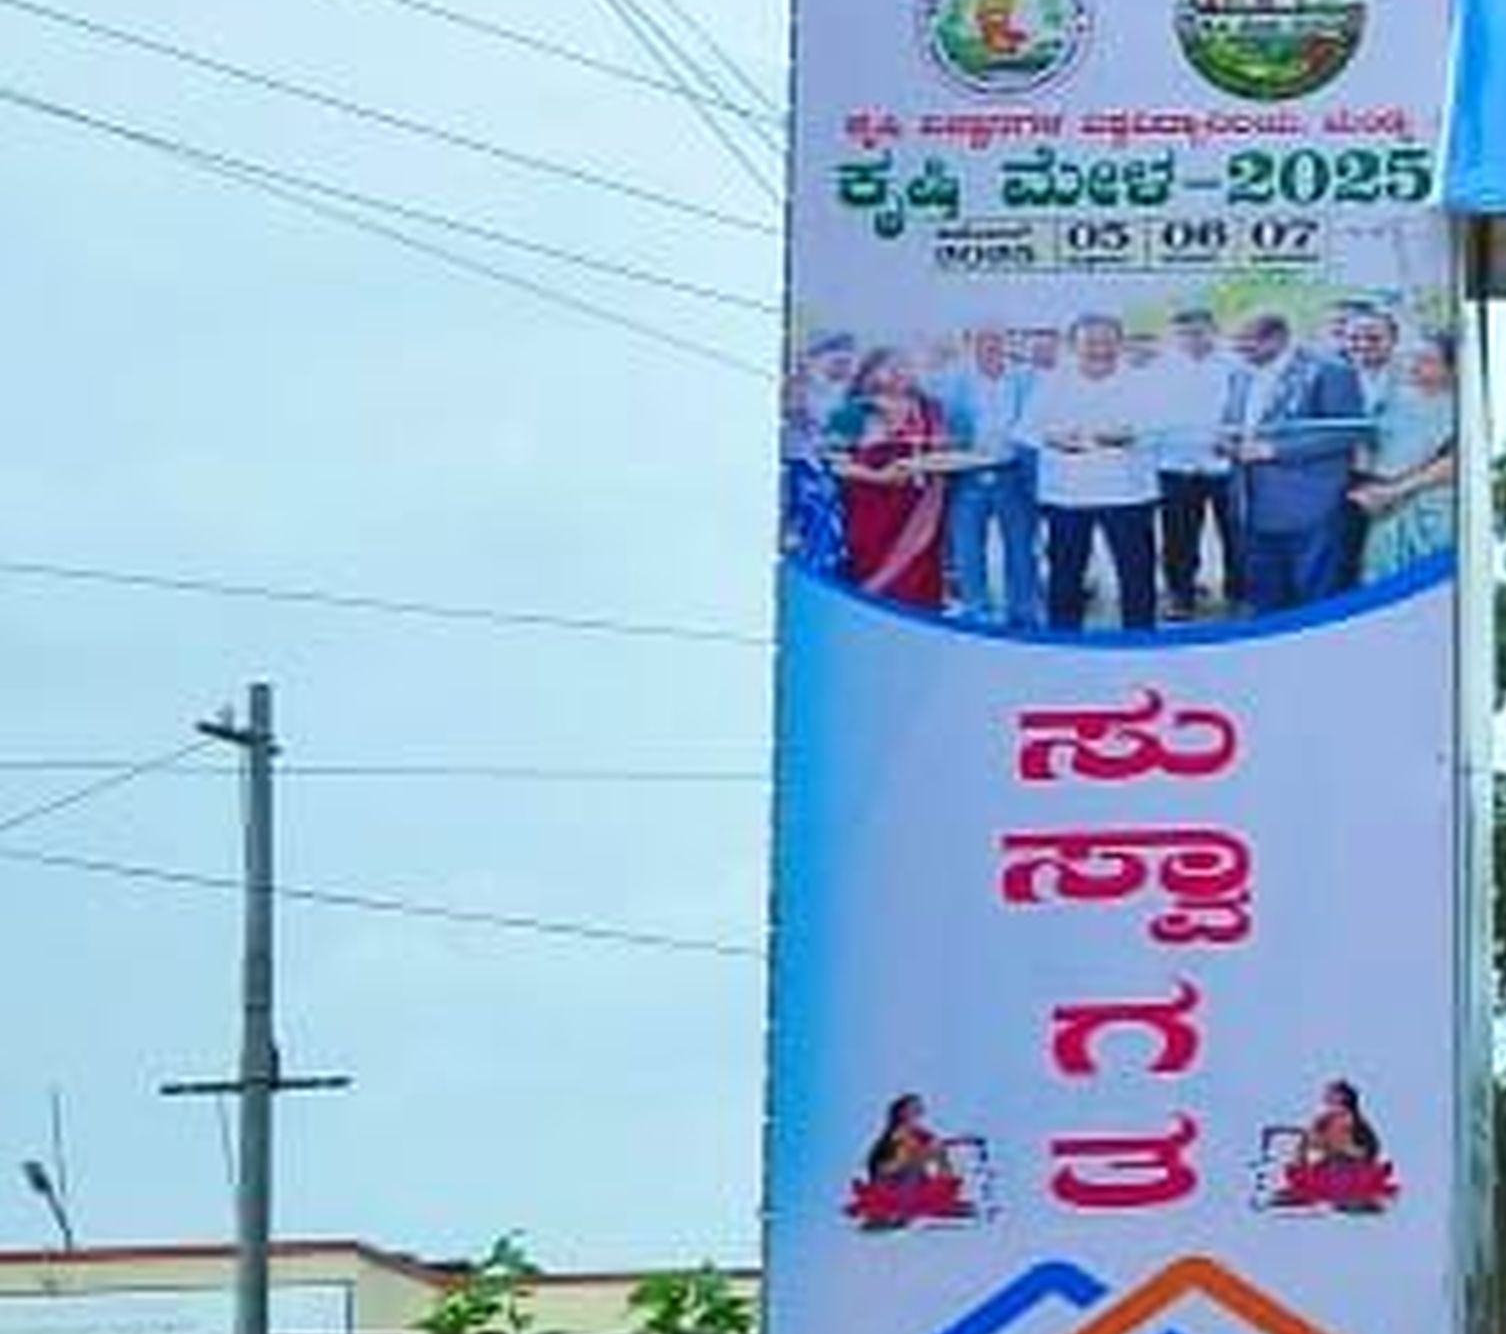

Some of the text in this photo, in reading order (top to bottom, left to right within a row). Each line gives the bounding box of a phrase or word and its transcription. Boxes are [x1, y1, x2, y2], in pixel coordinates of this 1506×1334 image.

[837, 152, 960, 239] ಕೃಷಿ
[1066, 219, 1131, 251] 05
[1250, 219, 1321, 250] 07
